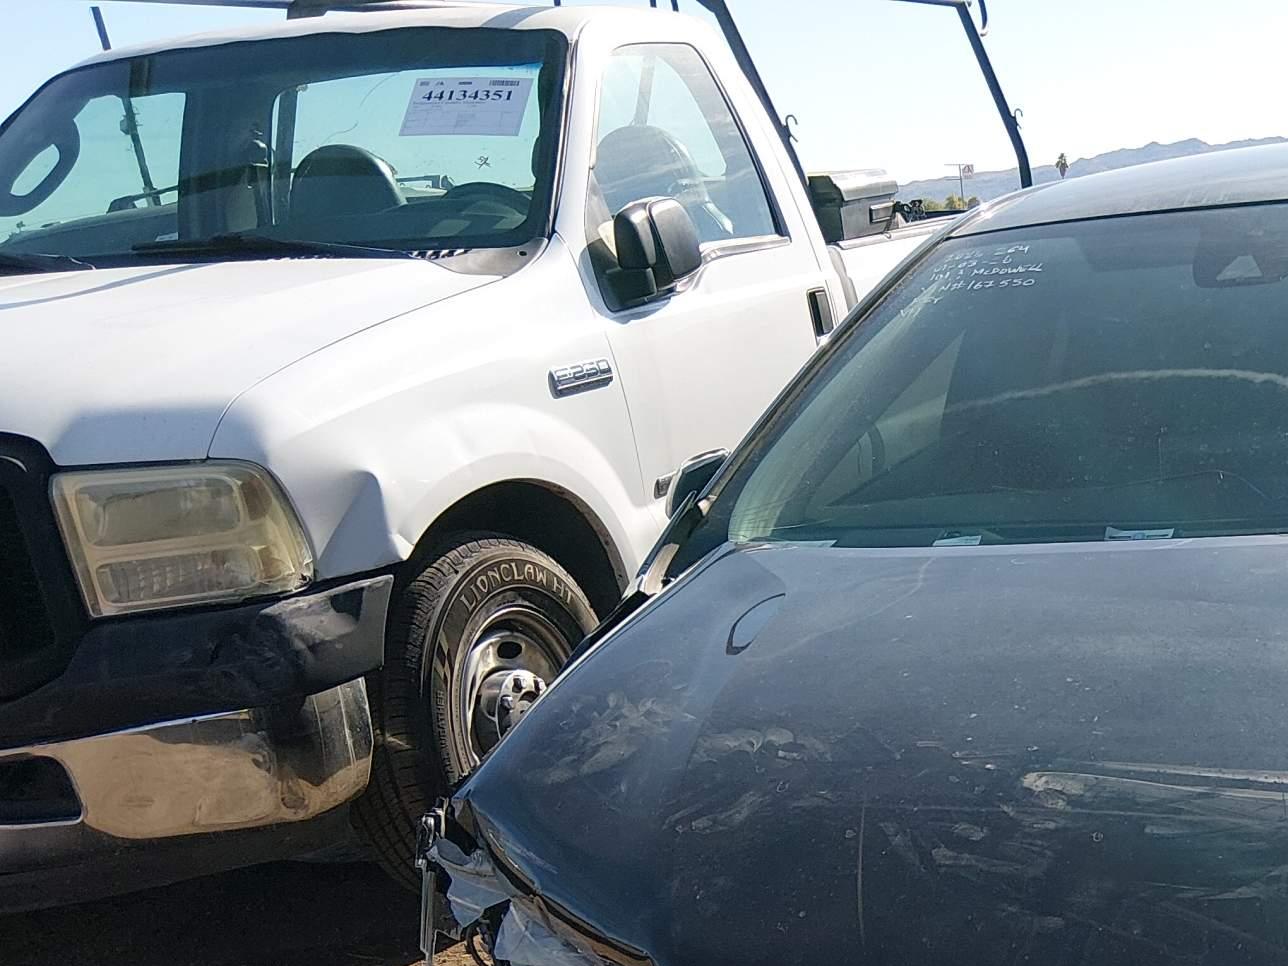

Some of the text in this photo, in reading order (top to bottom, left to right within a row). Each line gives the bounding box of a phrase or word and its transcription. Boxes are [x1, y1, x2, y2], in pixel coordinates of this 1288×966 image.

[422, 90, 513, 101] 44134351
[459, 562, 574, 611] LIONCLAW HT
